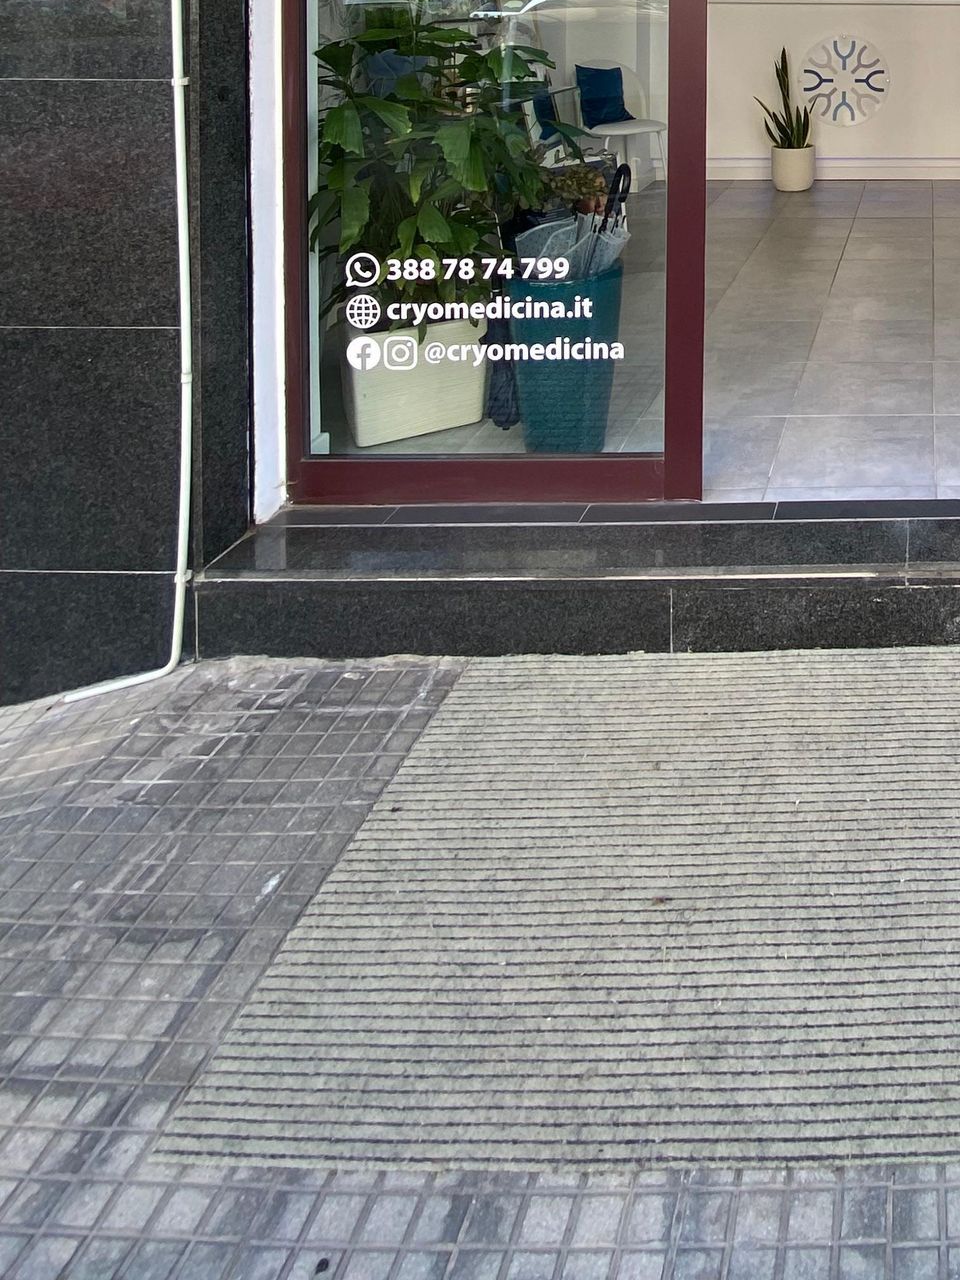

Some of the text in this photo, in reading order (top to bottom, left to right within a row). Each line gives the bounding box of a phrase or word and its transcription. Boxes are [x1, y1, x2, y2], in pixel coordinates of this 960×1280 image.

[386, 257, 570, 281] 388 78 74 799
[386, 296, 593, 325] cryomedicina.it
[424, 337, 625, 367] @cryomedicina
